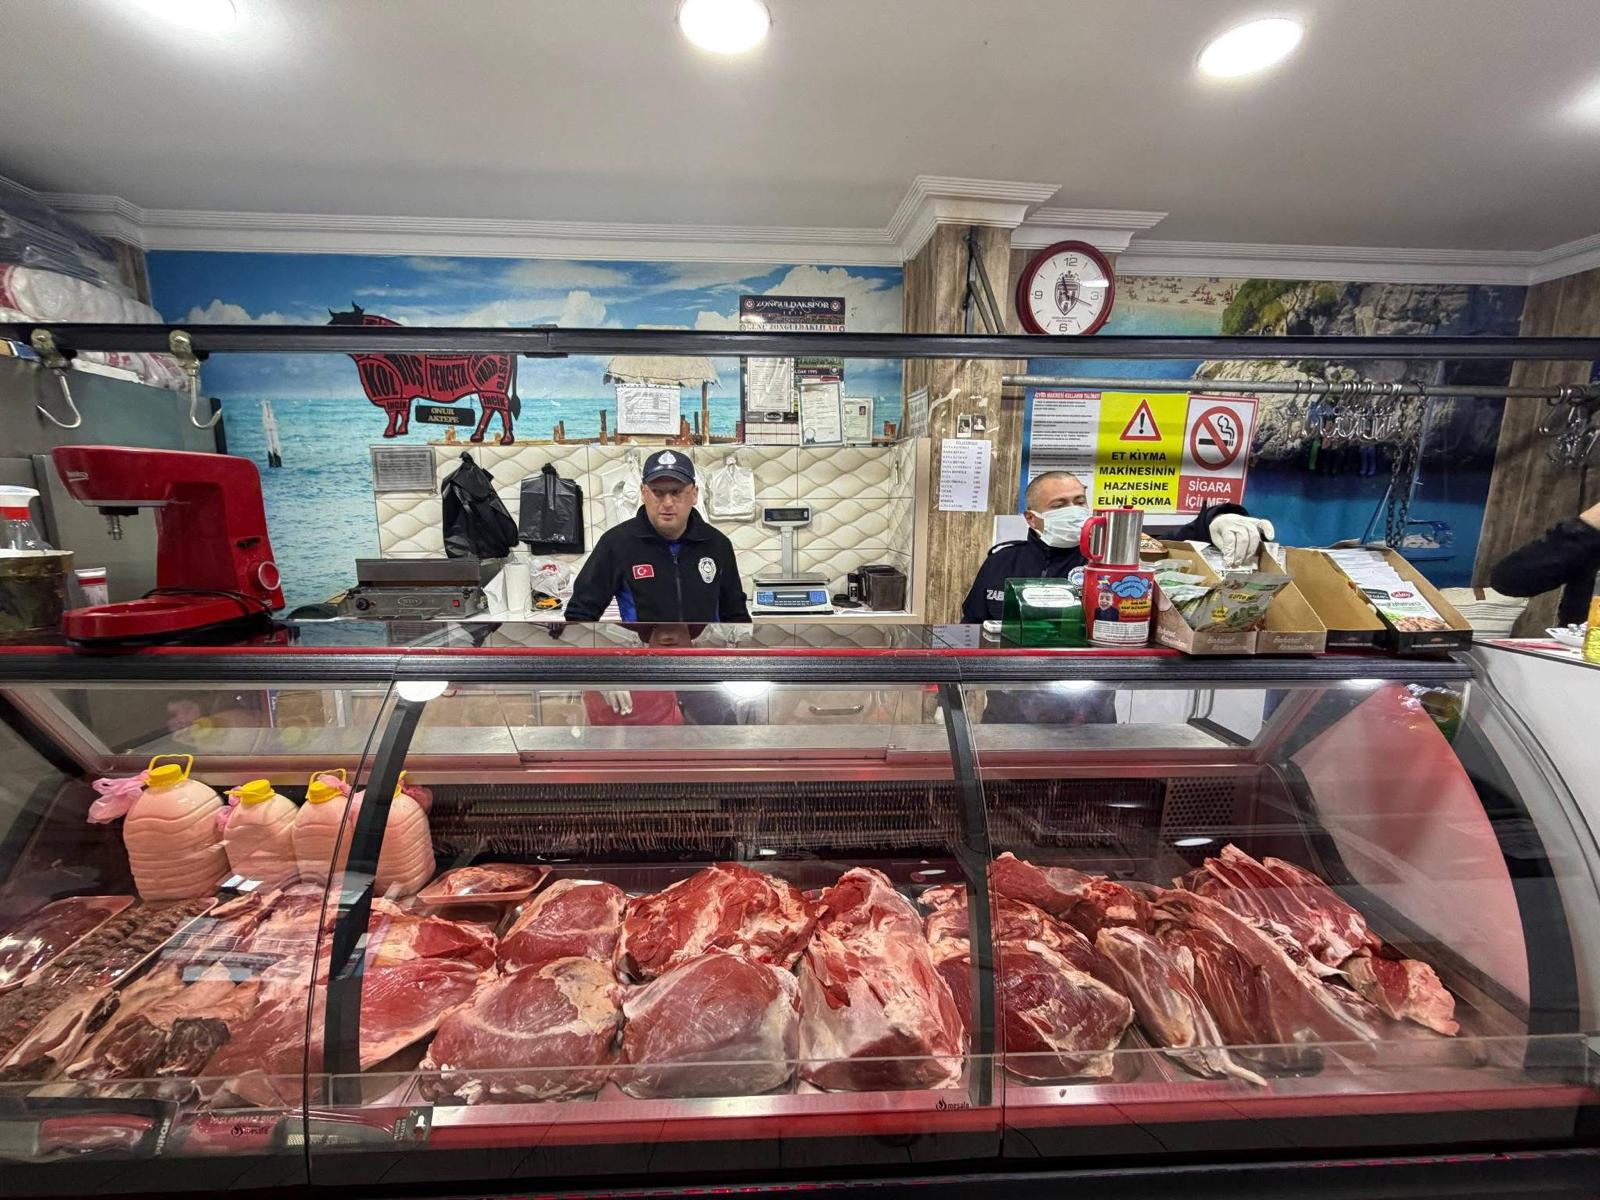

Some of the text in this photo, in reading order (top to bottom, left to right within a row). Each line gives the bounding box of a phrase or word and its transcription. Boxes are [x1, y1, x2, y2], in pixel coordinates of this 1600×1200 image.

[1064, 257, 1078, 266] 12
[1034, 291, 1043, 299] 9
[1091, 291, 1099, 300] 3
[1059, 323, 1067, 332] 6
[363, 363, 399, 396] KOL
[1111, 451, 1126, 460] ET
[1100, 465, 1175, 476] MAKİNESİNİN
[1104, 480, 1168, 491] HAZNESİNE
[1188, 478, 1231, 493] SİGARA
[1098, 495, 1171, 506] ELİNİ SOKMA
[987, 589, 1005, 601] ZAB
